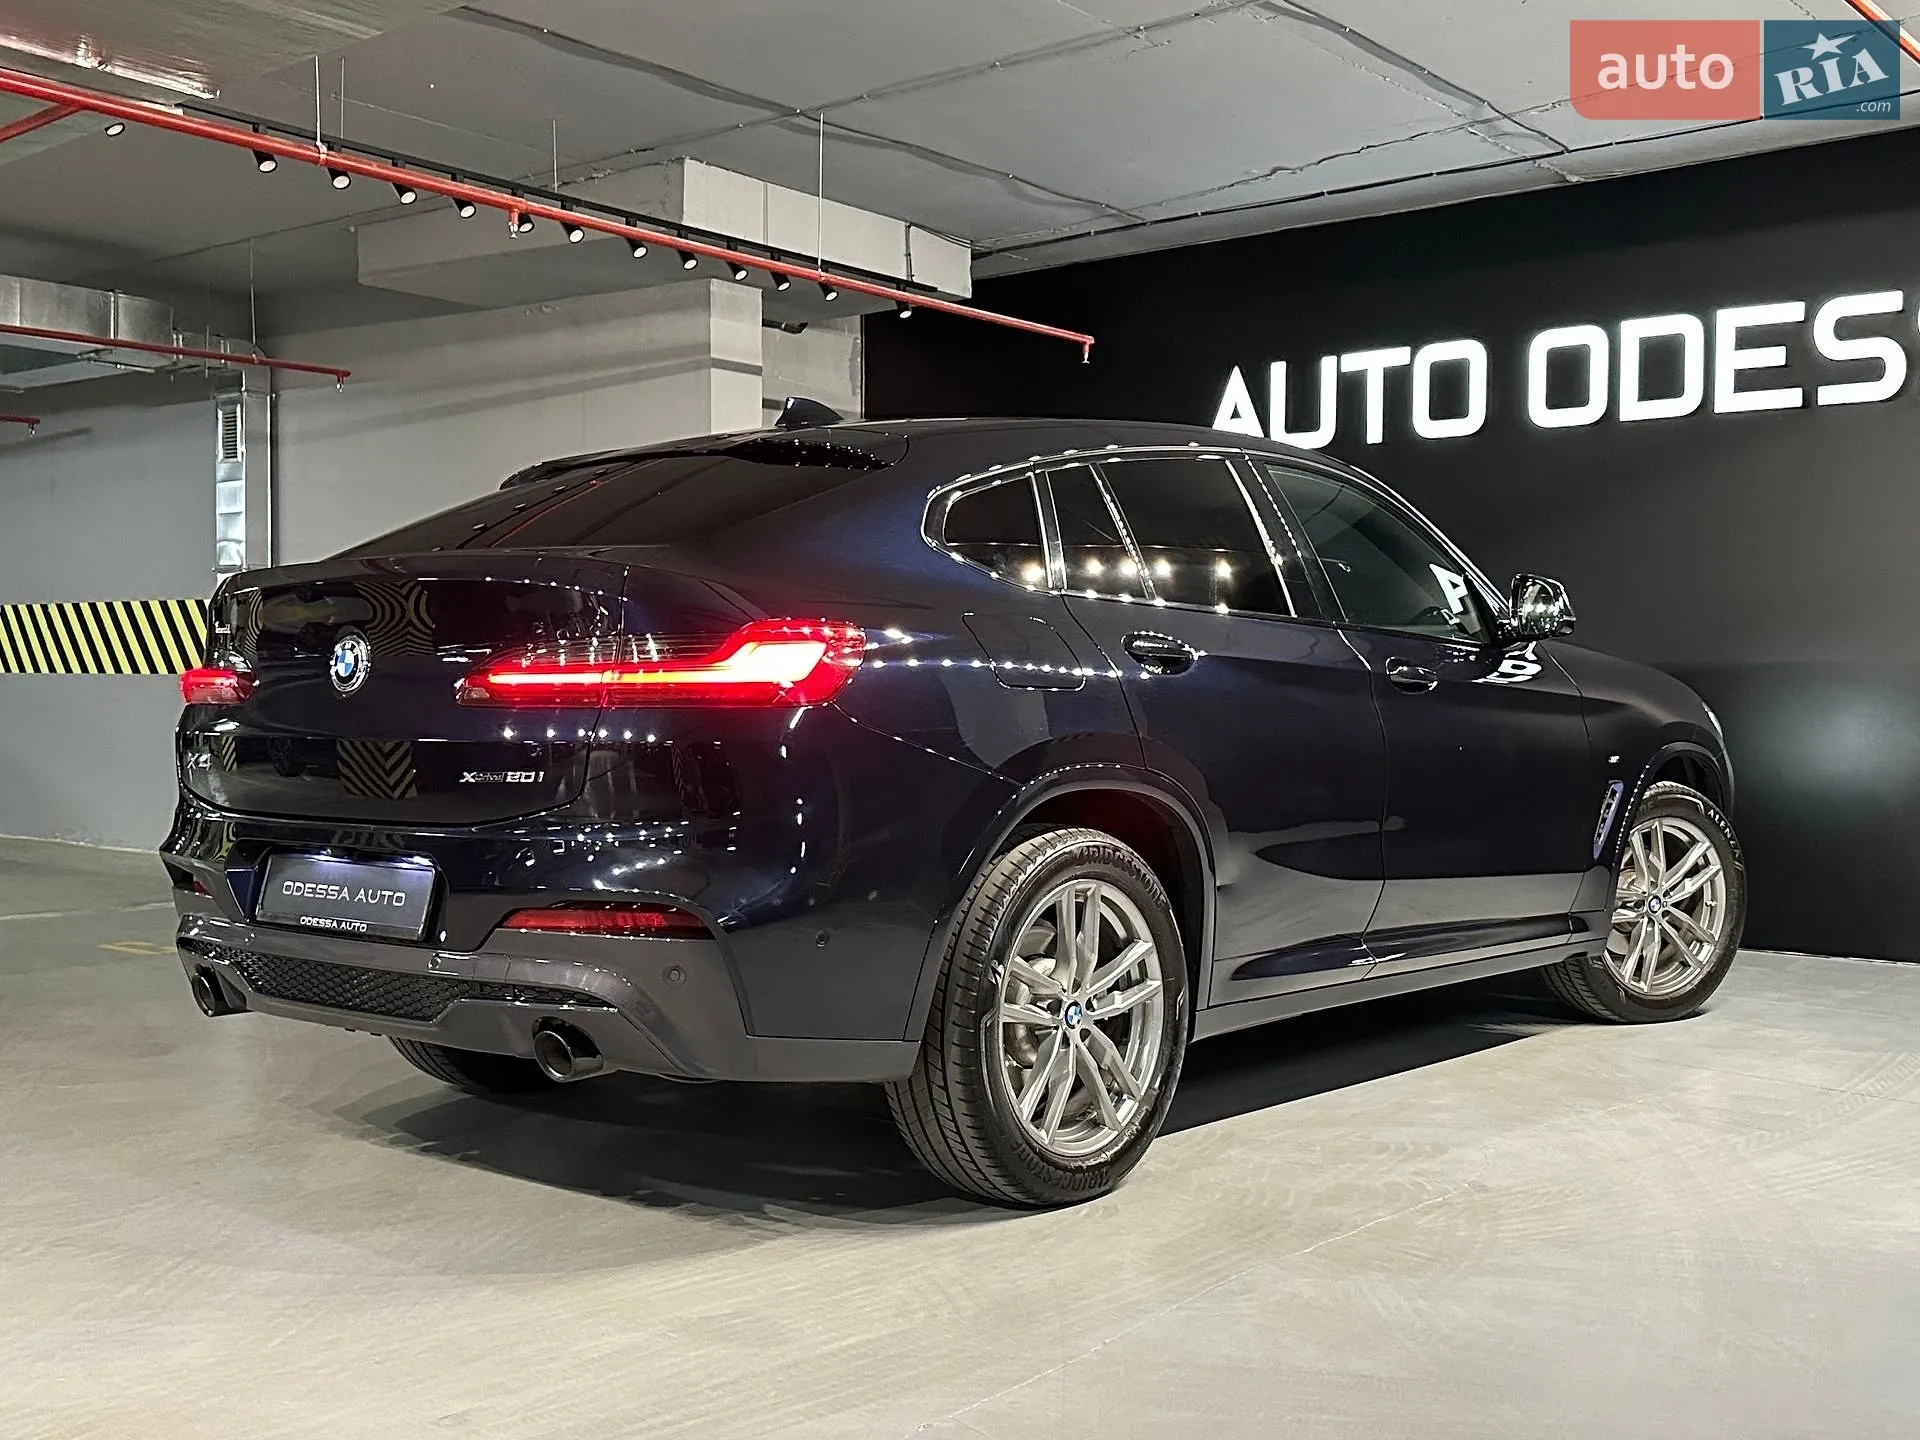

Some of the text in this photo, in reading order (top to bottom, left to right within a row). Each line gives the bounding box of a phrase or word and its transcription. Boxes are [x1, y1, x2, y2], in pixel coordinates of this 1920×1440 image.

[1211, 289, 1920, 450] AUTO ODES
[186, 752, 212, 771] X4
[282, 880, 406, 907] ODESSA AUTO
[300, 916, 368, 932] ODESSA AUTO
